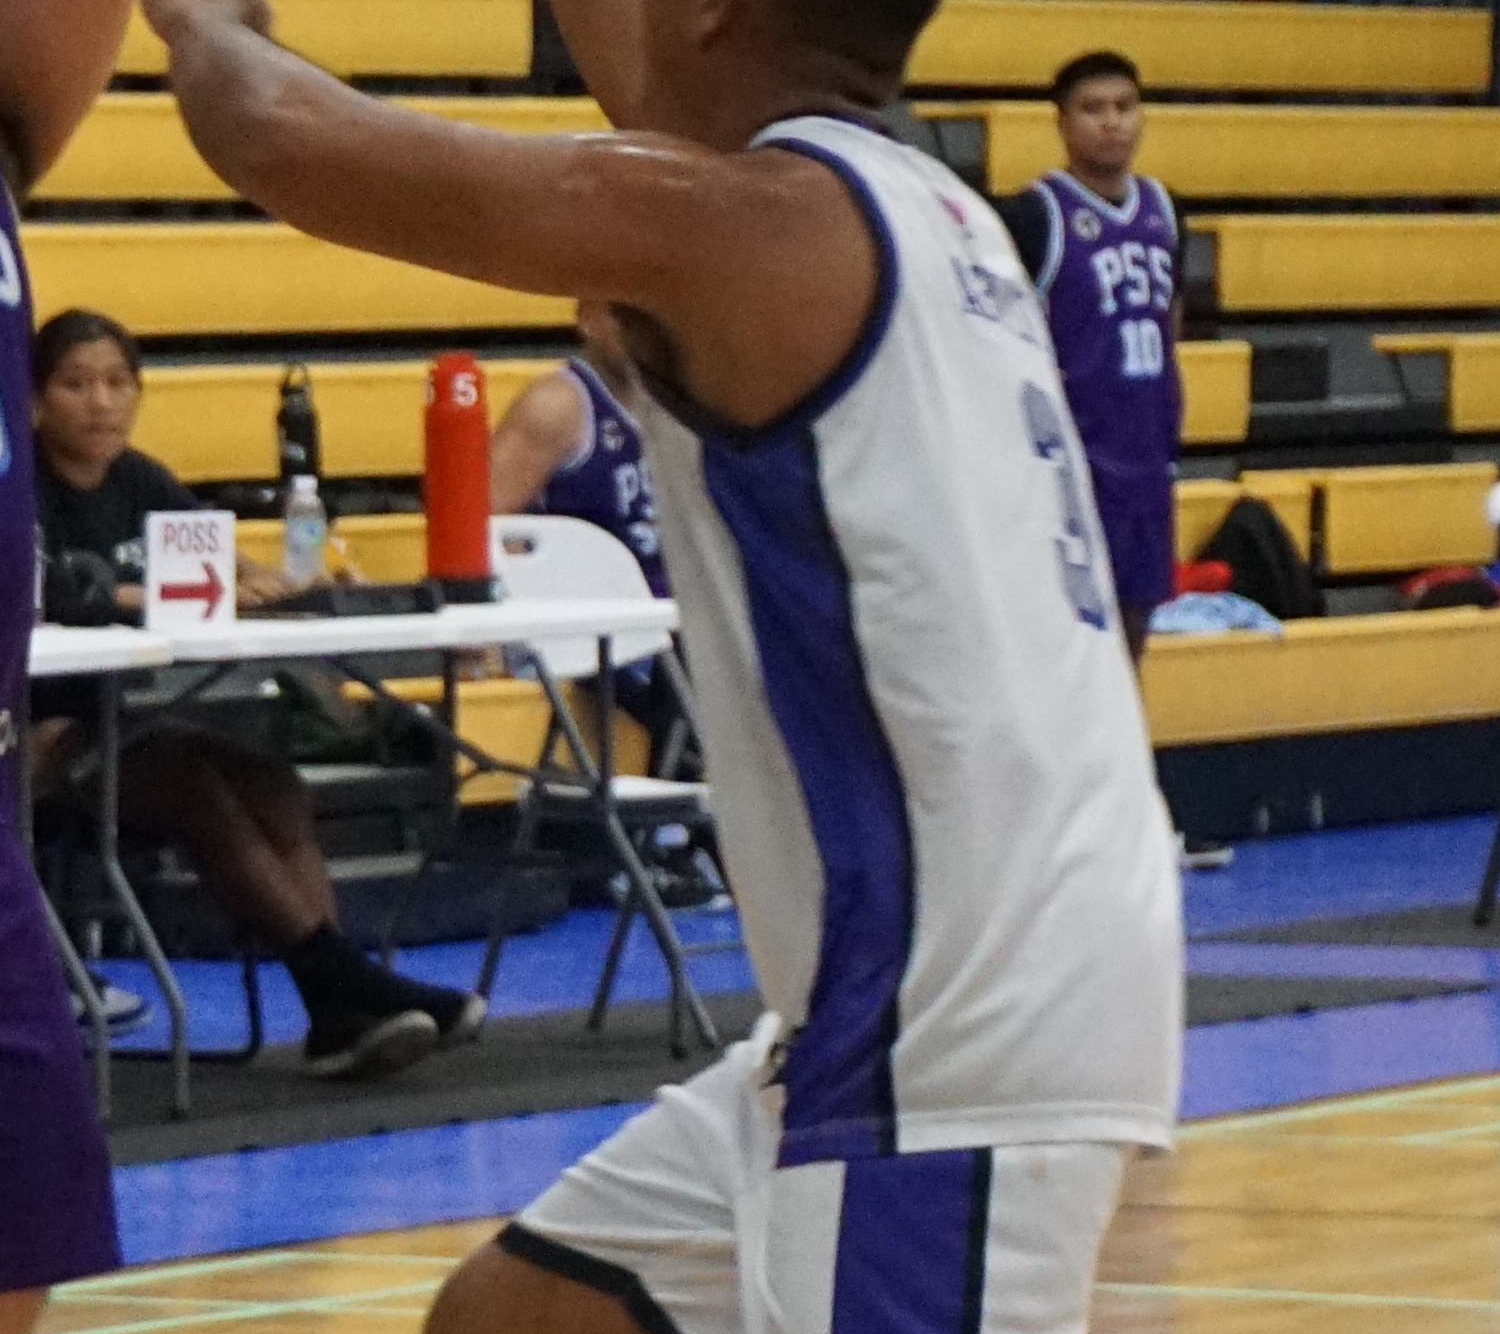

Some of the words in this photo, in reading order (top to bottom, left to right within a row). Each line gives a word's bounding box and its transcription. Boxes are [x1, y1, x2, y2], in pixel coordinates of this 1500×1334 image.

[1092, 241, 1174, 315] PSS
[1120, 318, 1164, 379] 10
[163, 521, 219, 553] POSS
